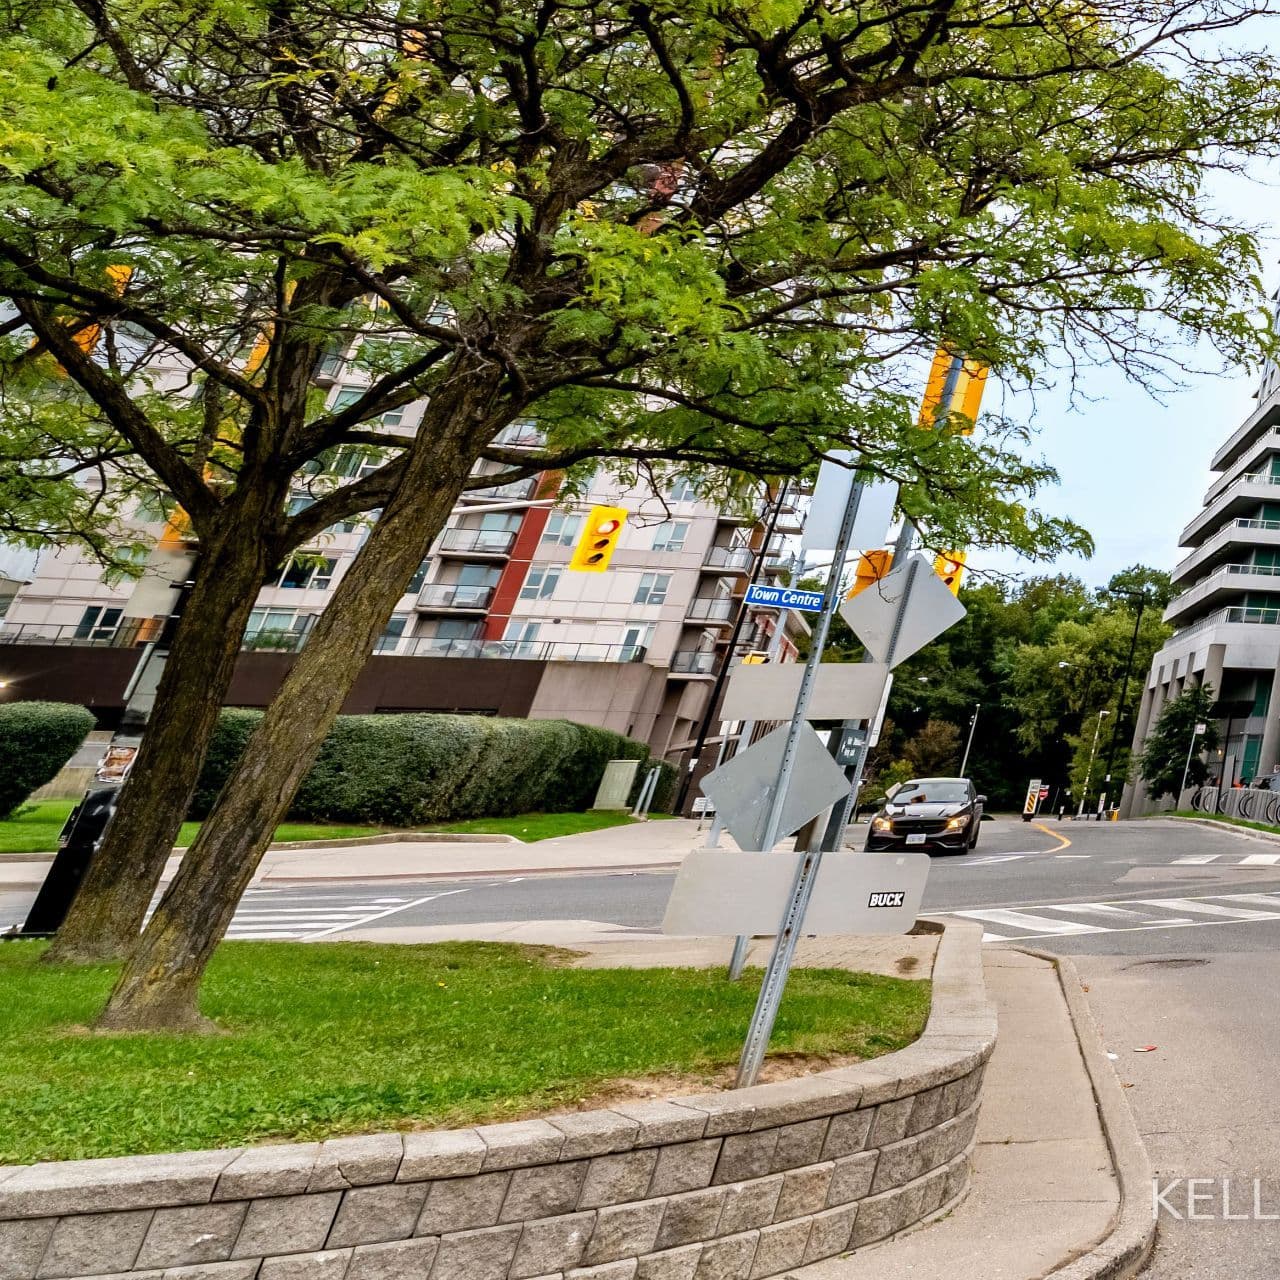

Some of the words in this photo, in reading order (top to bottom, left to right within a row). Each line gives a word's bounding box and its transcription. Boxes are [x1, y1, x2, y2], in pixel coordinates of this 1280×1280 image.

[751, 586, 779, 601] Town
[782, 591, 820, 607] Centre
[870, 893, 903, 907] BUCK
